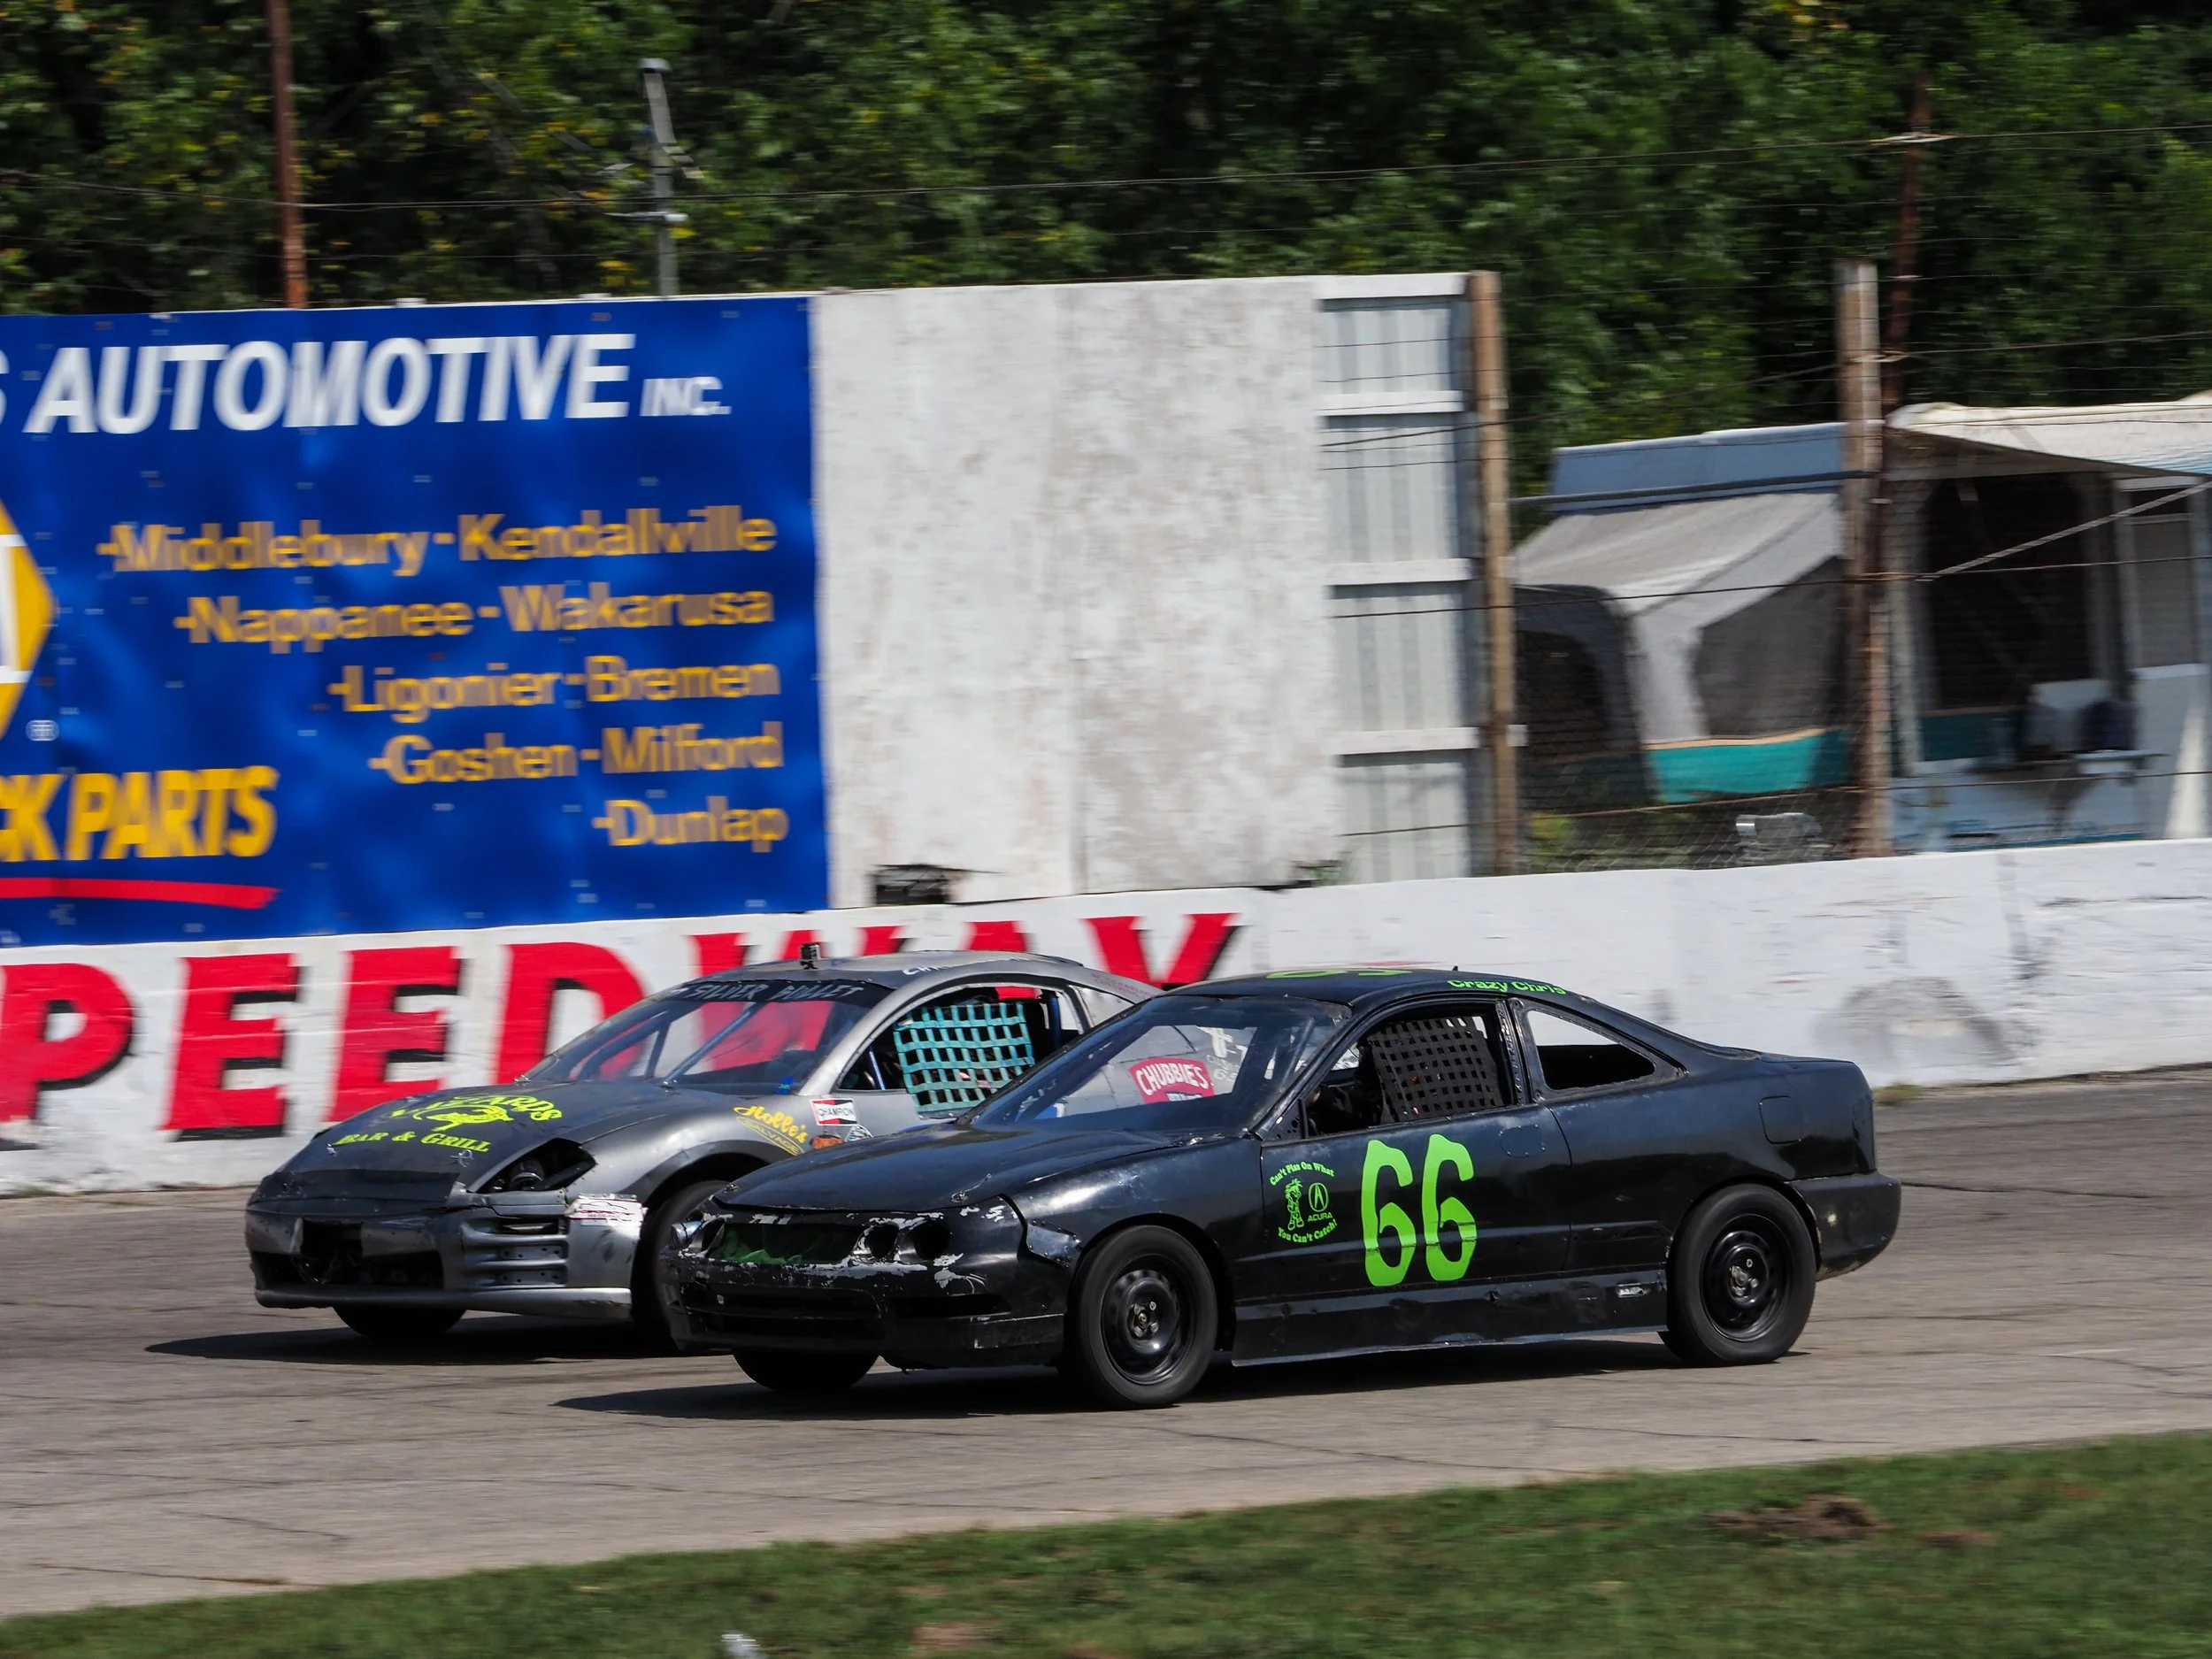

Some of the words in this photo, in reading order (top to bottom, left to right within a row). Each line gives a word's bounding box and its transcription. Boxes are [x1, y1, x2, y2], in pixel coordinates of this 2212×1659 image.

[23, 334, 636, 434] AUTOMOTIVE
[641, 376, 731, 417] INC.
[111, 520, 432, 577] Middlebury
[458, 505, 779, 562] Kendallville
[189, 596, 473, 653] Nappanee
[501, 584, 775, 633] Wakarusa
[343, 666, 565, 723] Ligonier
[587, 657, 781, 704] Bremen
[384, 735, 578, 785] Goshen
[603, 722, 785, 775] Milford
[65, 765, 280, 860] PARTS
[608, 798, 788, 852] Dunlap
[1448, 979, 1508, 992] Crazy
[1511, 980, 1567, 995] Chris
[392, 1131, 416, 1142] &
[818, 1106, 855, 1118] CHAMPION
[1270, 1169, 1287, 1186] Can't
[1301, 1161, 1312, 1171] On
[1312, 1162, 1335, 1177] What
[1278, 1226, 1292, 1241] You
[1293, 1233, 1313, 1243] Can't
[1314, 1218, 1338, 1240] Catch!
[1308, 1211, 1333, 1222] ACURA
[1361, 1133, 1478, 1287] 66
